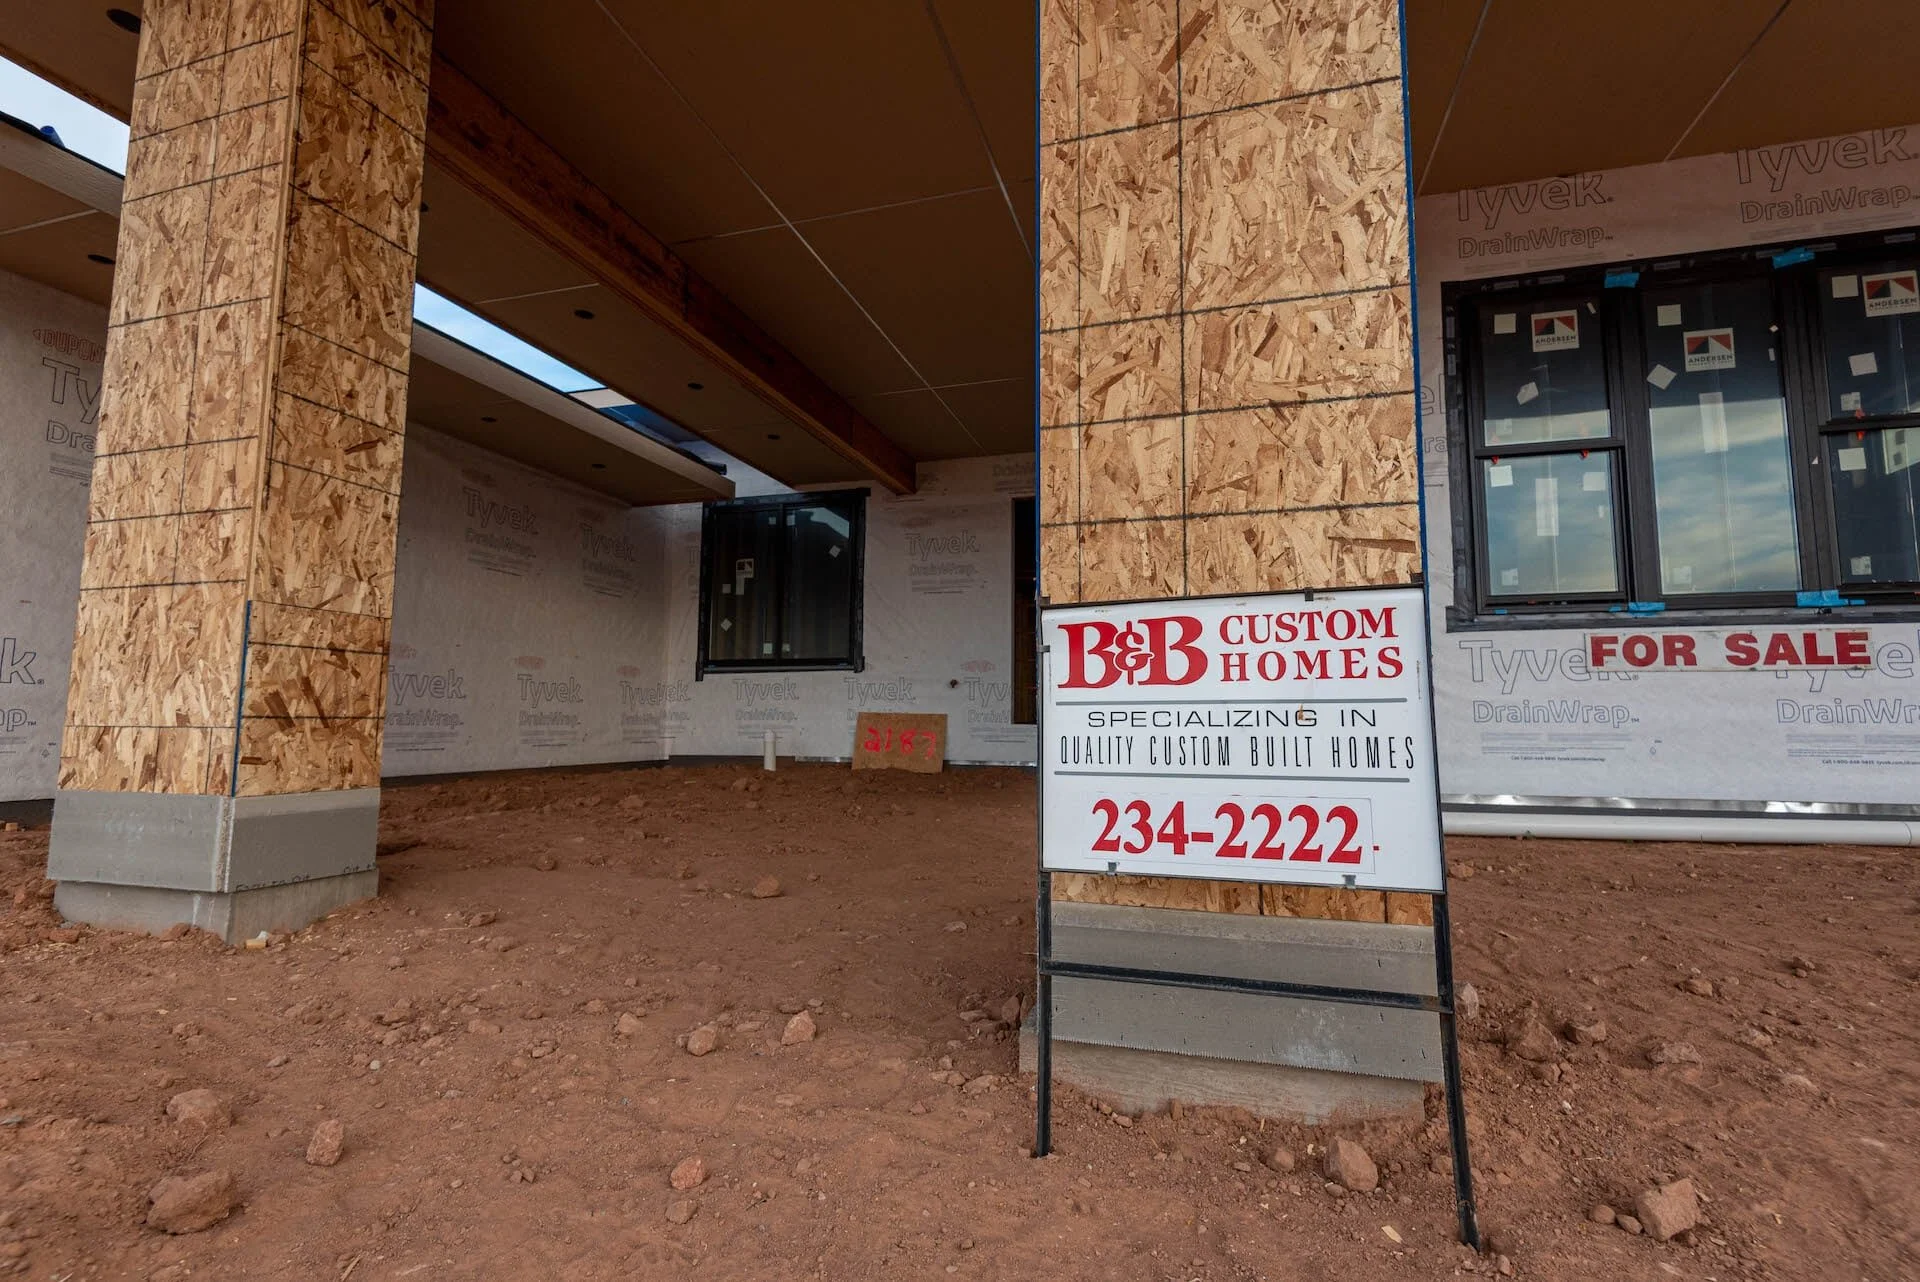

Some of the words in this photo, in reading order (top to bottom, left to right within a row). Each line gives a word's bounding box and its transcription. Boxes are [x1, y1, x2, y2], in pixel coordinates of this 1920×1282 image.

[1741, 186, 1912, 223] DrainWrap
[1458, 226, 1605, 259] DrainWrap
[1688, 354, 1734, 363] ANDERSEN
[903, 529, 977, 561] Tyvek
[1057, 615, 1208, 689] B&B
[1219, 607, 1399, 646] CUSTOM
[1219, 646, 1404, 683] HOMES
[1590, 634, 1698, 667] FOR
[1725, 631, 1872, 667] SALE
[1459, 640, 1632, 694] Tyve
[516, 673, 582, 708] Tyvek
[732, 677, 797, 707] Tyvek
[844, 677, 914, 706] Tyvek
[963, 677, 1011, 708] Tyv
[1087, 709, 1318, 728] SPECIALIZING
[1341, 709, 1376, 727] IN
[1473, 699, 1631, 728] DrainWrap
[1776, 698, 1920, 724] DrainWr
[1060, 735, 1134, 765] QUALITY
[1149, 736, 1231, 767] CUSTOM
[1250, 736, 1313, 768] BUILT
[1331, 736, 1414, 770] HOMES
[1091, 798, 1363, 865] 234-2222
